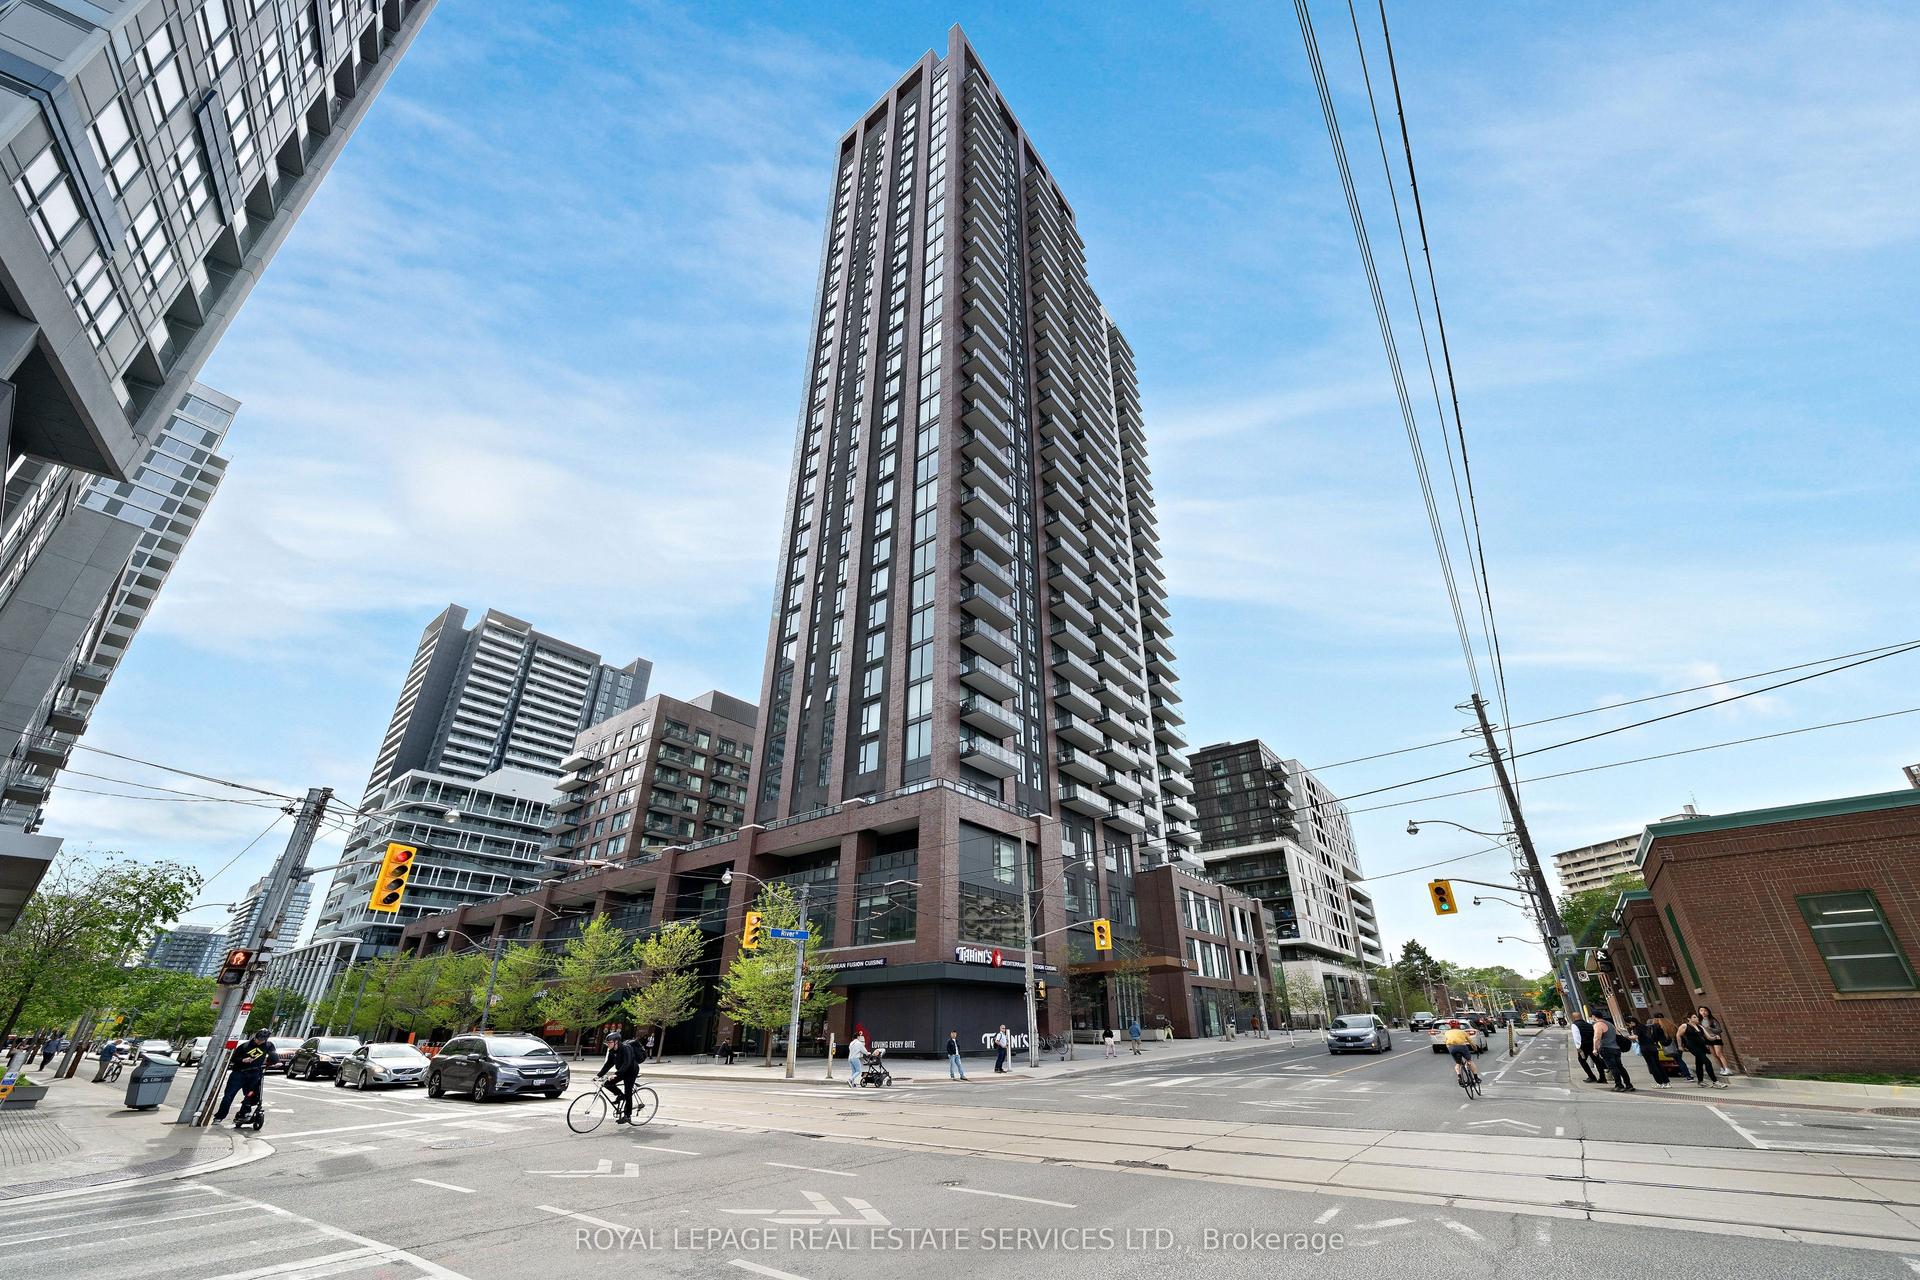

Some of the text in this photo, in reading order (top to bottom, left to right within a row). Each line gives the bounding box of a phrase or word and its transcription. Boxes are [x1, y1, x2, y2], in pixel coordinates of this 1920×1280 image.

[780, 930, 795, 938] River
[809, 962, 846, 971] MEDERRANEAN
[846, 960, 864, 968] FUSION
[871, 1040, 916, 1049] LOVING EVERY BITE
[981, 1032, 1029, 1049] TNI'S
